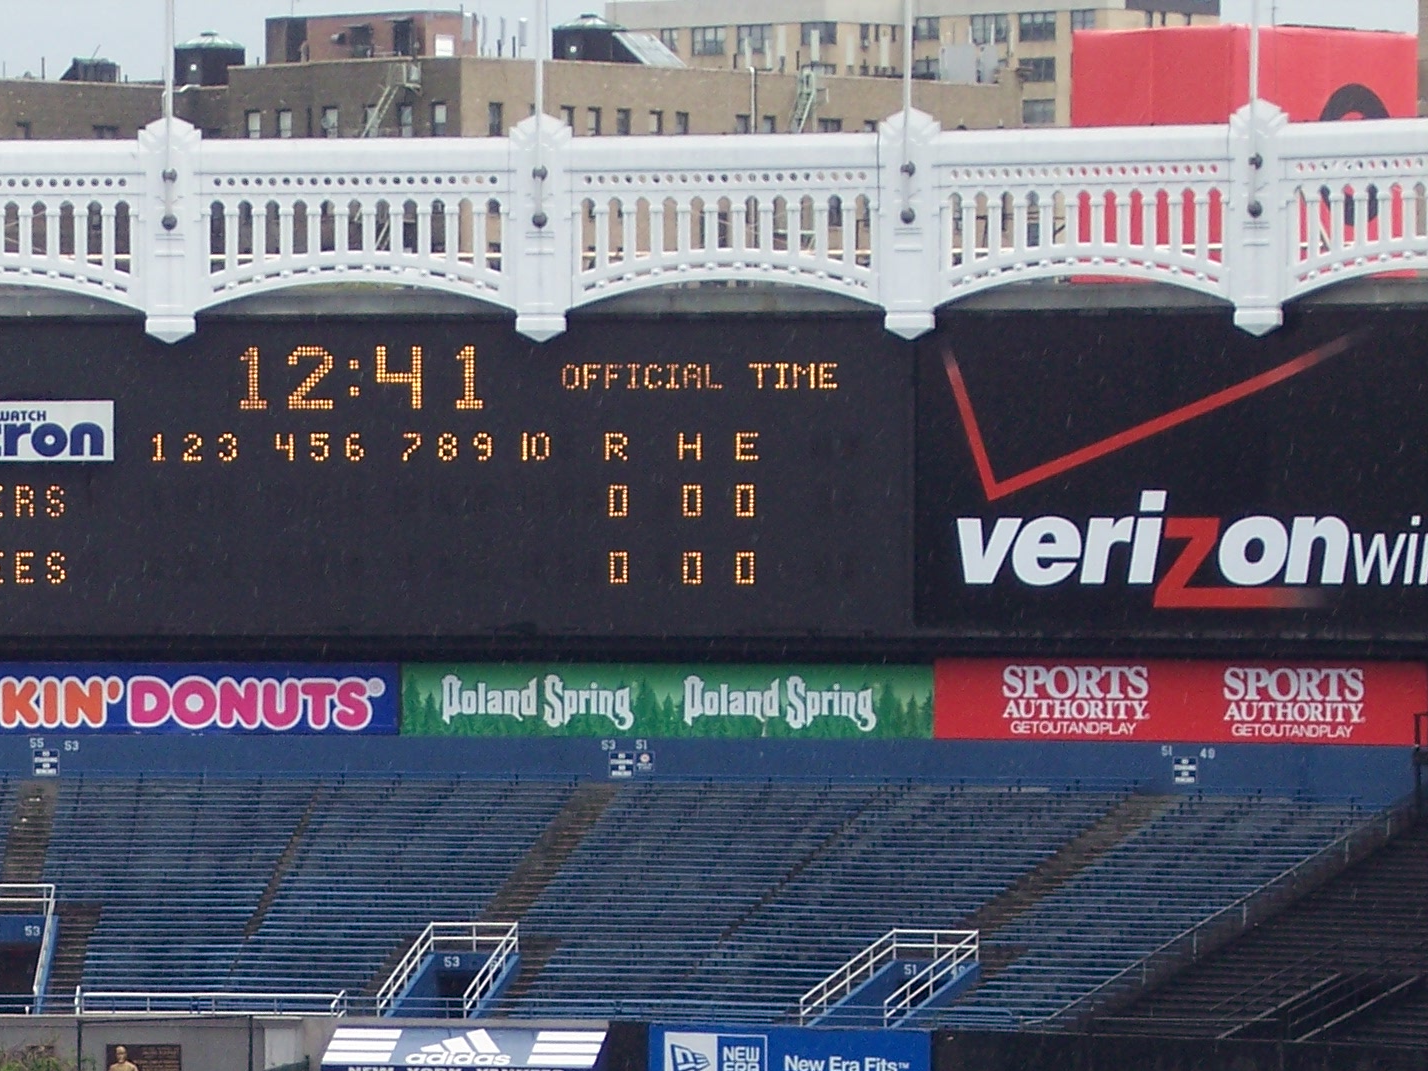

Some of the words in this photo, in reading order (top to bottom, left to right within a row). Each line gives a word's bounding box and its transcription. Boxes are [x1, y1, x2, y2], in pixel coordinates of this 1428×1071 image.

[239, 345, 484, 410] 12:41
[562, 363, 723, 390] OFFICIAL
[748, 362, 839, 390] TIME
[521, 433, 550, 462] 10
[604, 432, 628, 461] R
[677, 432, 702, 461] H
[735, 432, 759, 461] E
[608, 484, 628, 518] 0
[682, 484, 702, 518] 0
[735, 484, 755, 518] 0
[608, 551, 628, 585] 0
[682, 551, 702, 585] 0
[735, 551, 755, 585] 0
[1002, 666, 1149, 700] SPORTS
[1224, 668, 1364, 702] SPORTS
[127, 675, 372, 731] DONUTS
[440, 674, 538, 726] Poland
[543, 674, 634, 730] Spring
[683, 675, 780, 725] Poland
[786, 675, 877, 732] Spring
[1002, 699, 1150, 721] AUTHORITY
[1224, 702, 1365, 723] AUTHORITY
[1010, 721, 1137, 735] GETOUTANDPLAY
[1232, 724, 1353, 739] GETOUTANDPLAY
[64, 740, 79, 751] 53
[636, 739, 647, 750] 51
[24, 925, 41, 936] 53
[444, 956, 460, 968] 53
[904, 964, 917, 975] 51
[405, 1052, 511, 1066] adidas
[723, 1046, 760, 1062] NEW
